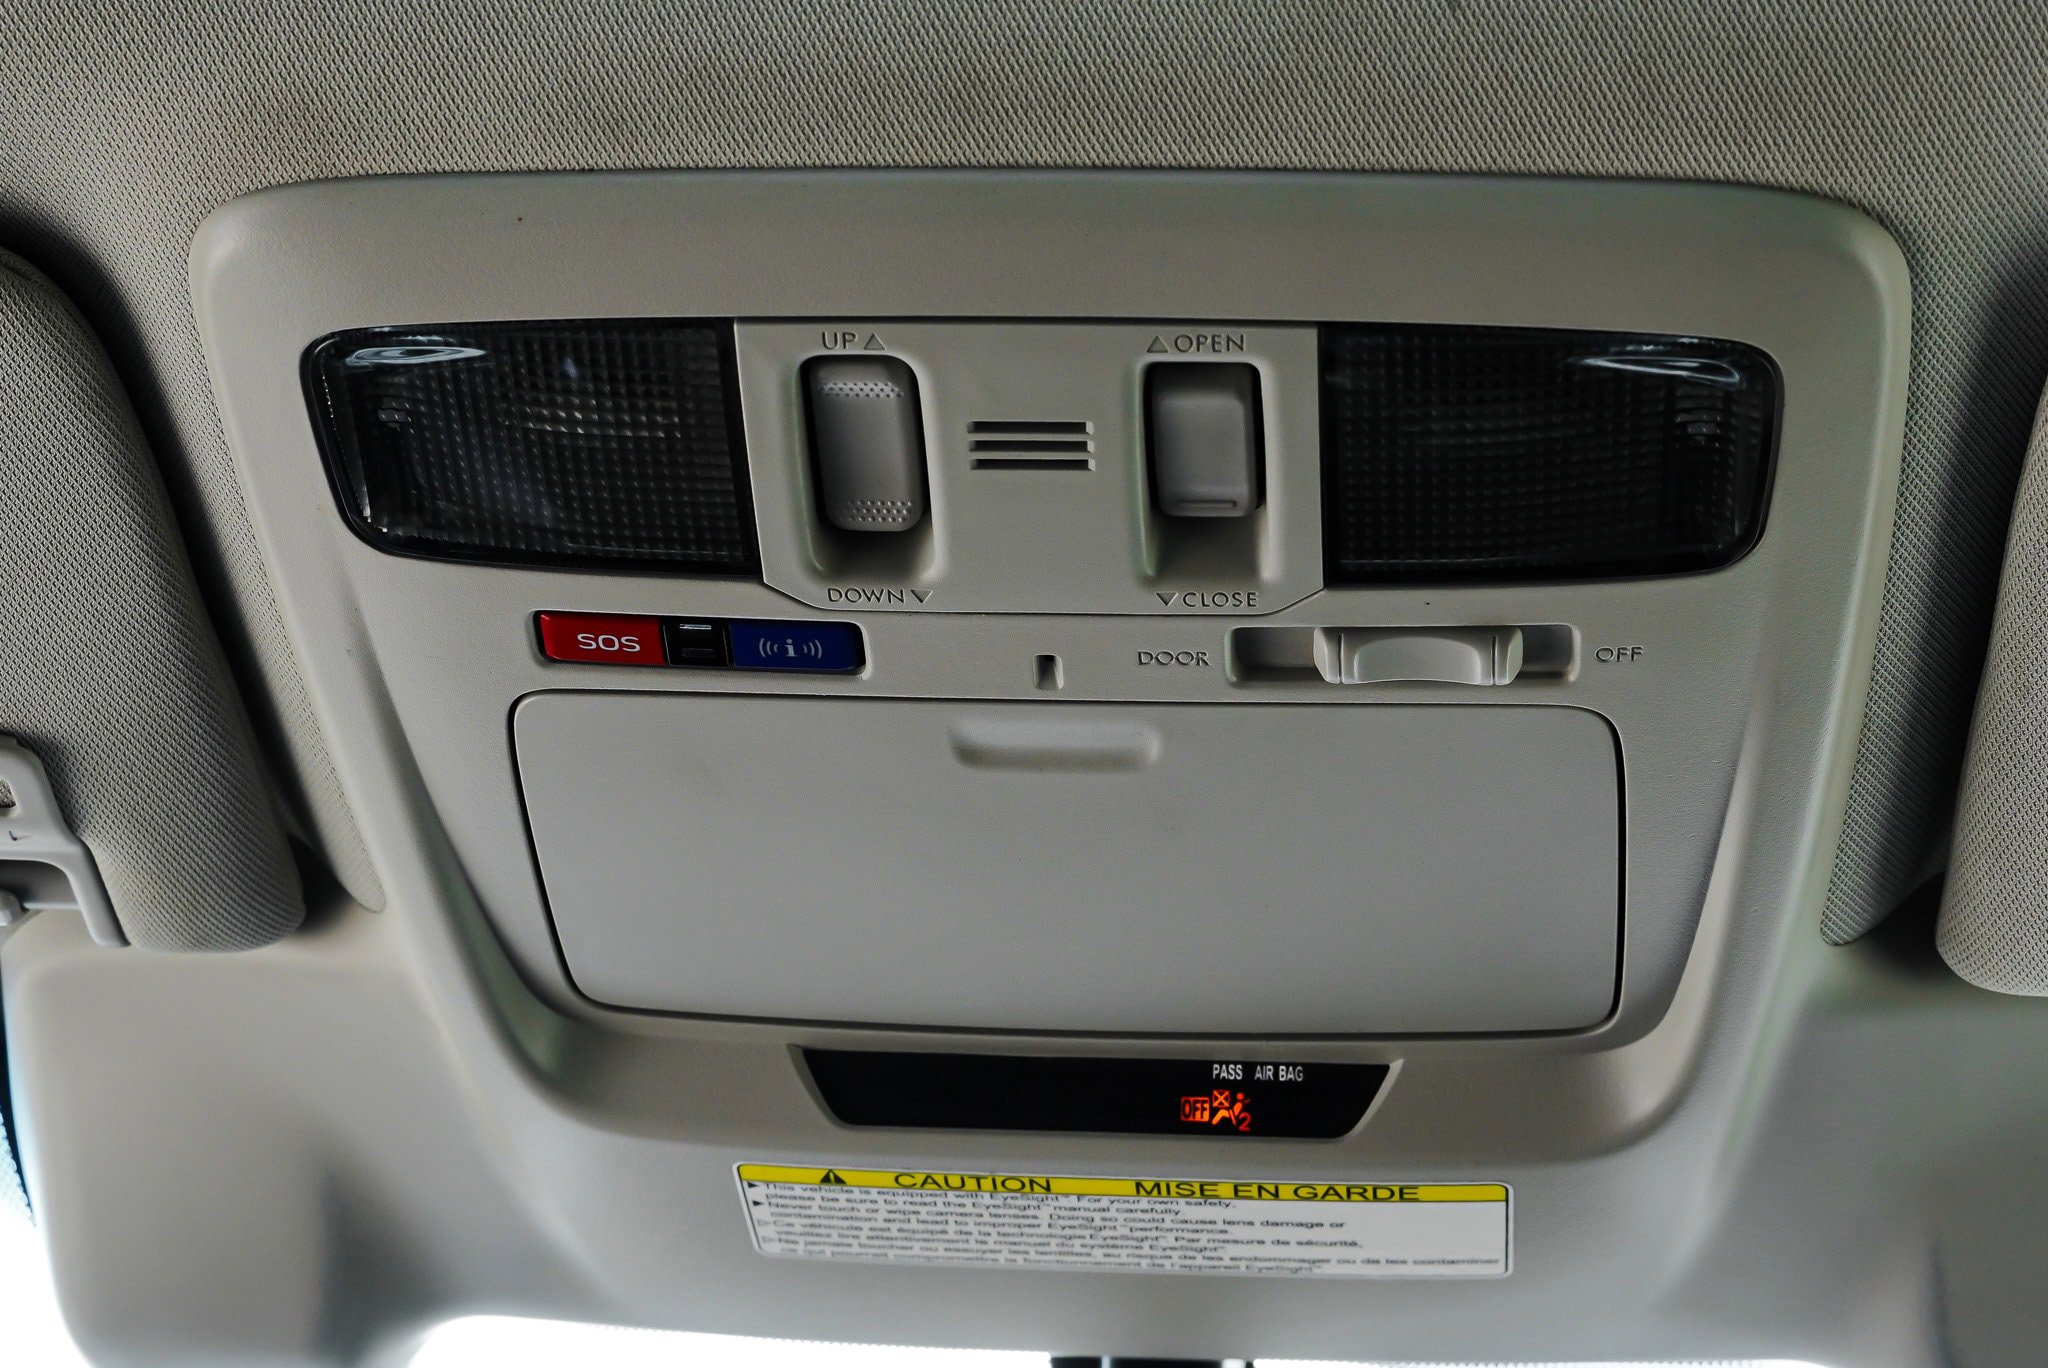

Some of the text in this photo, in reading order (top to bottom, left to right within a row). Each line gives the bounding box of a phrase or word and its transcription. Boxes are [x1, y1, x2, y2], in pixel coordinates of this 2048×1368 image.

[821, 330, 858, 351] UP
[1174, 334, 1246, 353] OPEN
[827, 587, 906, 604] DOWN
[1182, 591, 1259, 608] CLOSE
[576, 633, 641, 652] SOS
[1137, 650, 1211, 667] DOOR
[1595, 646, 1644, 662] OFF
[1212, 1064, 1304, 1082] PASS AIR BAG
[1181, 1098, 1210, 1122] OFF
[1238, 1111, 1252, 1131] 2
[894, 1174, 1052, 1192] CAUTION
[1135, 1182, 1420, 1201] MISE EN GARDE
[766, 1183, 795, 1192] This
[801, 1184, 854, 1194] vehicle
[859, 1186, 871, 1195] is
[877, 1189, 948, 1200] equipped
[953, 1192, 984, 1200] with
[1077, 1195, 1102, 1203] For
[1108, 1197, 1141, 1205] your
[1147, 1199, 1179, 1207] own
[766, 1192, 815, 1201] please
[821, 1194, 840, 1203] be
[845, 1197, 878, 1205] sure
[884, 1198, 898, 1206] to
[903, 1199, 938, 1207] read
[942, 1201, 966, 1209] the
[1054, 1205, 1110, 1213] manual
[768, 1202, 813, 1210] Never
[818, 1204, 861, 1213] touch
[865, 1206, 880, 1214] or
[886, 1207, 921, 1216] wipe
[926, 1210, 984, 1218] camera
[1049, 1213, 1094, 1223] Doing
[1100, 1215, 1118, 1223] so
[1123, 1216, 1165, 1224] could
[1171, 1218, 1217, 1226] cause
[1222, 1218, 1255, 1227] lens
[1260, 1219, 1324, 1229] damage
[770, 1212, 878, 1222] contamination
[883, 1216, 911, 1224] and
[916, 1217, 949, 1225] lead
[954, 1219, 969, 1227] to
[974, 1220, 1042, 1229] improper
